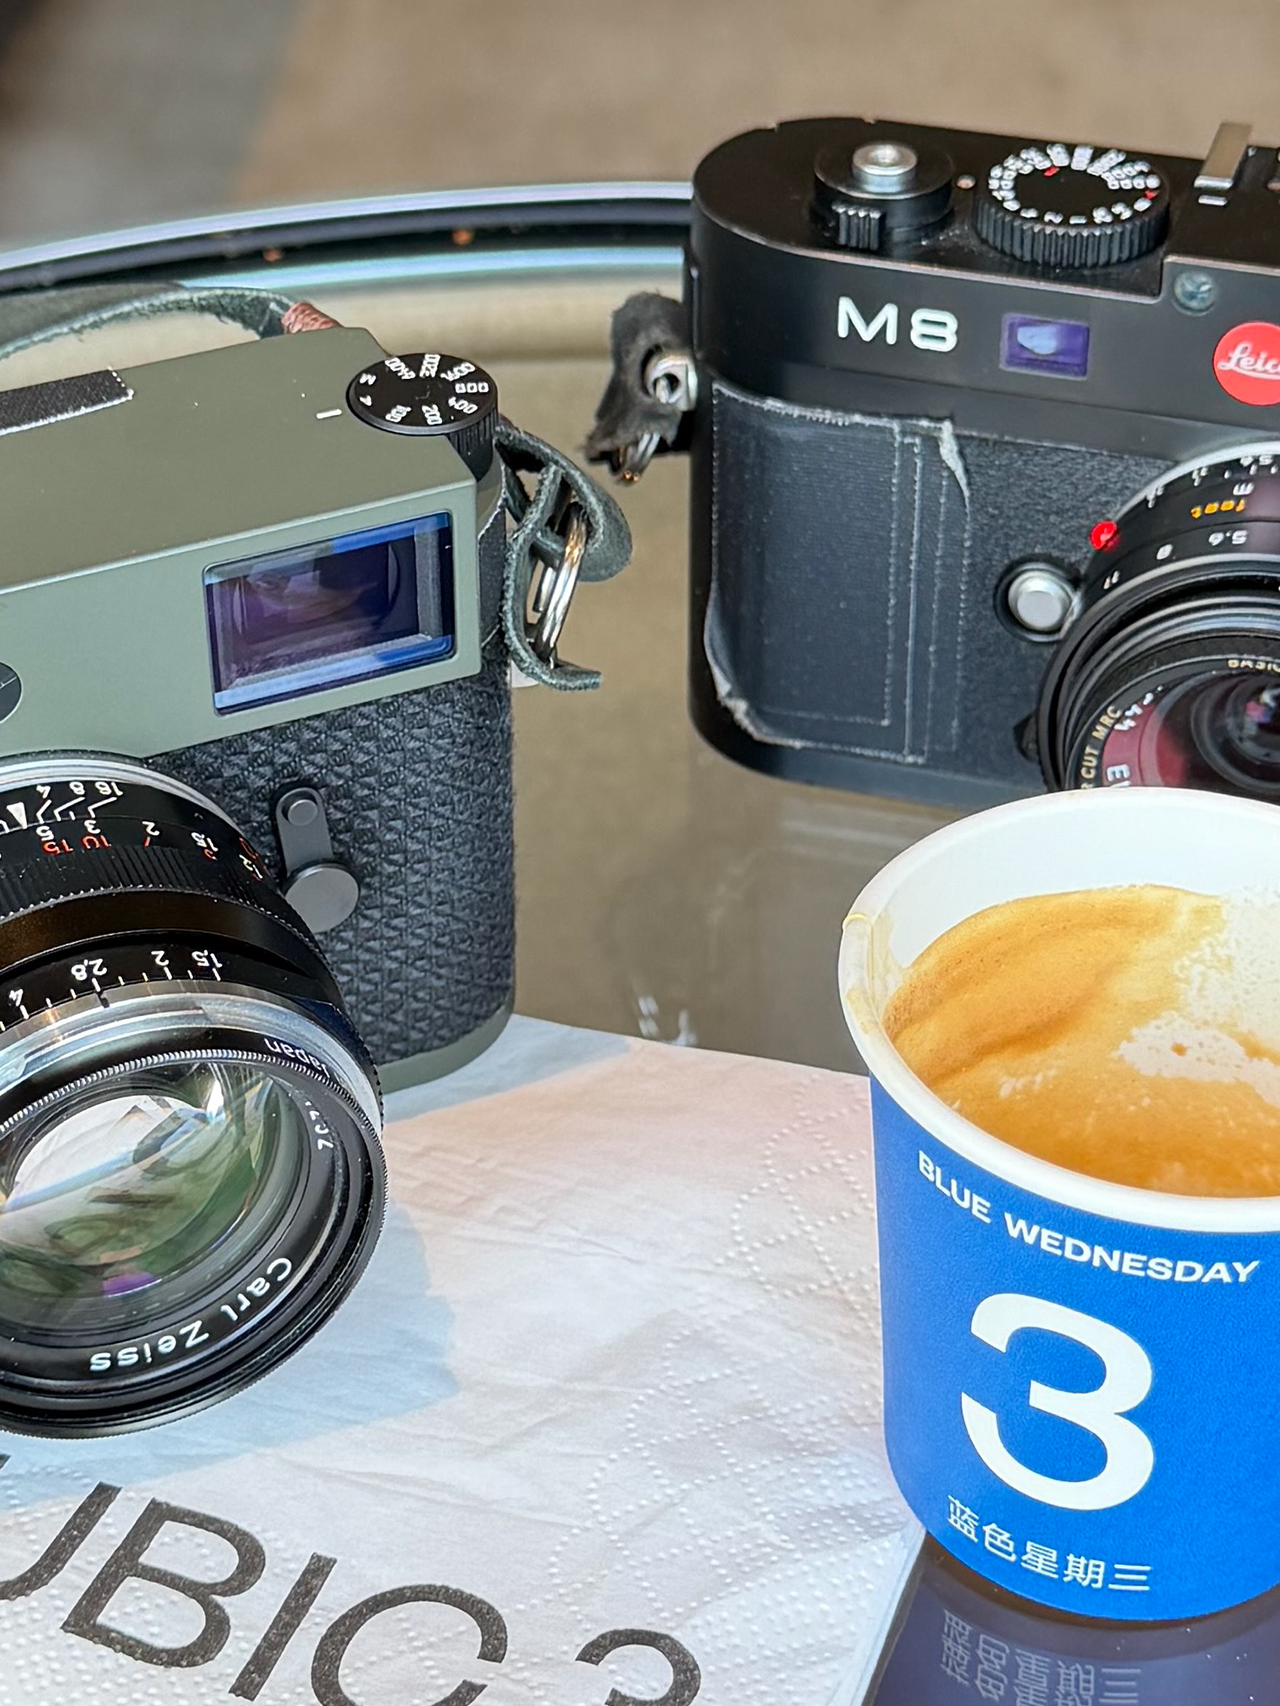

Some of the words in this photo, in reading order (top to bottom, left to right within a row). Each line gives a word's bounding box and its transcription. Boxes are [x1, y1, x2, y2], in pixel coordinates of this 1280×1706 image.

[836, 295, 959, 354] M8
[421, 404, 443, 425] 200
[448, 396, 478, 414] 400
[1082, 747, 1100, 780] CUT
[1092, 704, 1123, 740] MRC
[39, 825, 56, 843] 5
[84, 819, 101, 835] 3
[142, 820, 161, 836] 2
[71, 957, 108, 981] 2,8
[151, 950, 168, 966] 2
[9, 988, 24, 1005] 4
[917, 1150, 992, 1226] BLUE
[1002, 1211, 1261, 1285] WEDNESDAY
[220, 1256, 293, 1322] Carl
[88, 1320, 210, 1373] Zeiss
[961, 1292, 1155, 1511] 3
[944, 1495, 1153, 1594] 蓝色星期三
